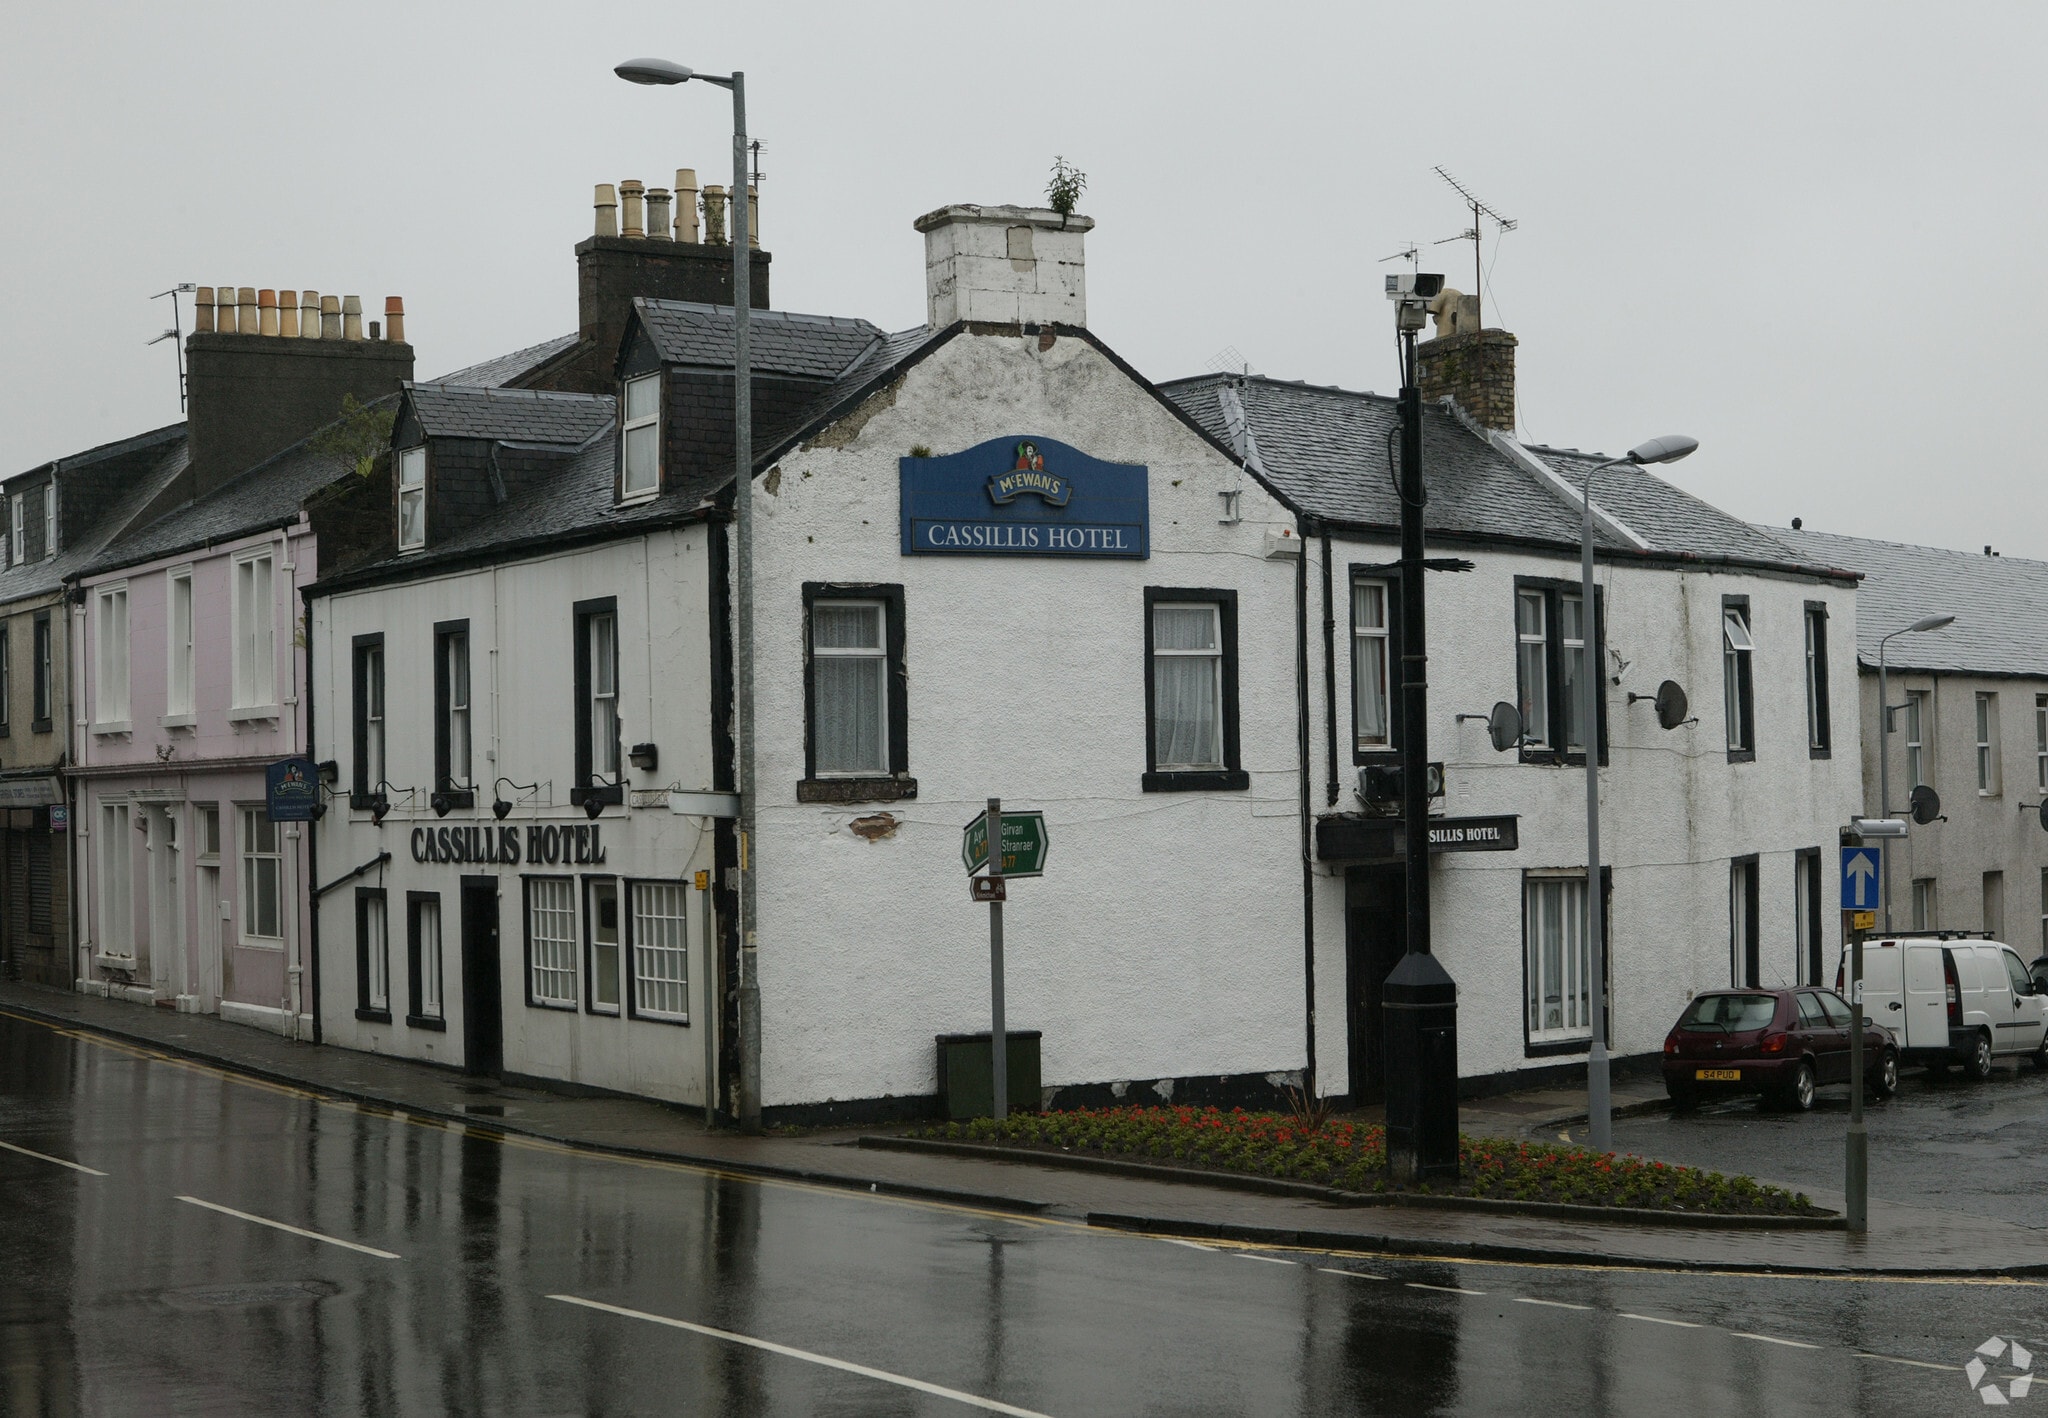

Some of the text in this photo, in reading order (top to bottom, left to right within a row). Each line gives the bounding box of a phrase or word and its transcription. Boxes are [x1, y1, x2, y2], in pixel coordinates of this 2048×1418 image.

[928, 524, 1128, 549] CASSILLIS HOTEL
[973, 829, 984, 844] Ayr
[1001, 823, 1023, 836] Girvan
[1429, 827, 1500, 843] SILLIS HOTEL
[411, 824, 606, 864] CASSILLIS HOTEL
[1001, 839, 1034, 852] Stranraer
[1703, 1070, 1715, 1079] S4
